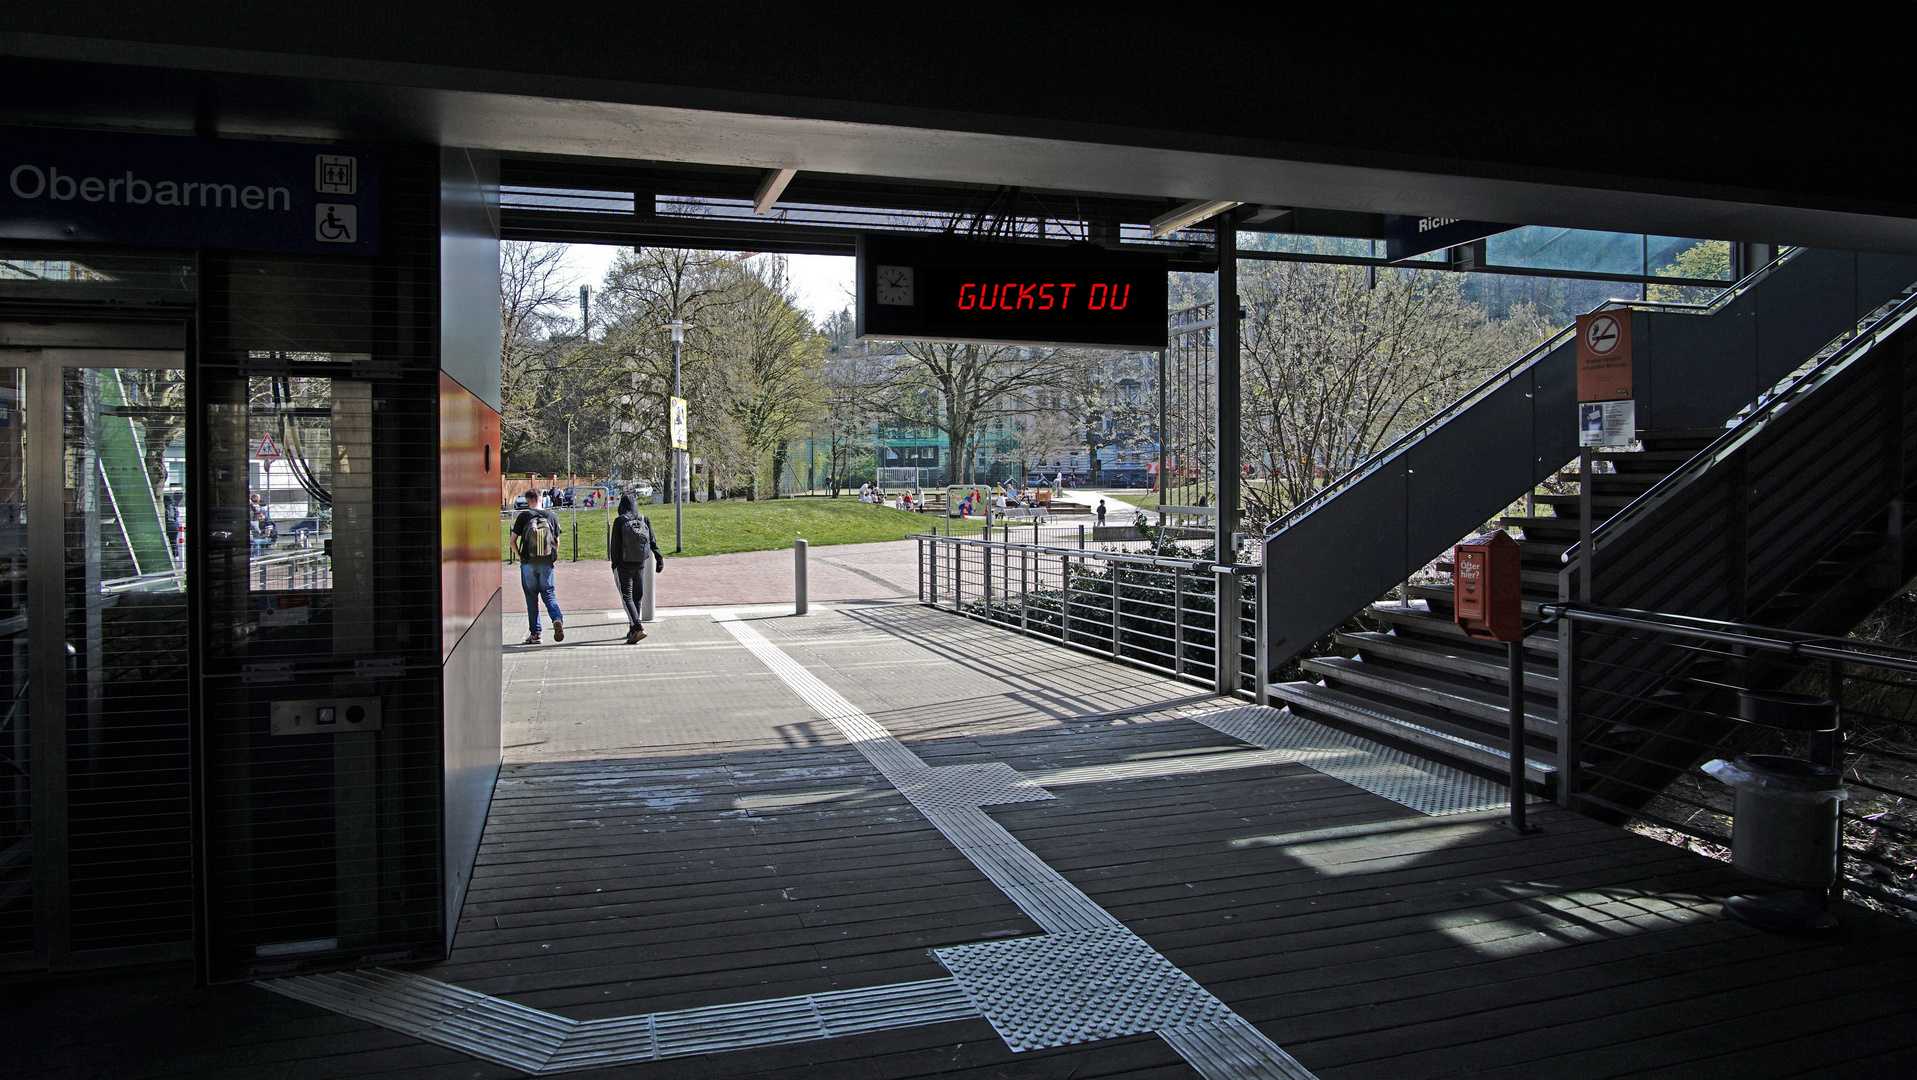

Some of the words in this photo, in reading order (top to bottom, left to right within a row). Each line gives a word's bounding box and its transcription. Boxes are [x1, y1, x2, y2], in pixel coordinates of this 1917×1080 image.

[9, 164, 291, 211] Oberbarmen
[958, 283, 1077, 311] GUCKST
[1088, 283, 1131, 311] DU
[1460, 560, 1480, 570] Öfter
[1460, 570, 1480, 579] hier?
